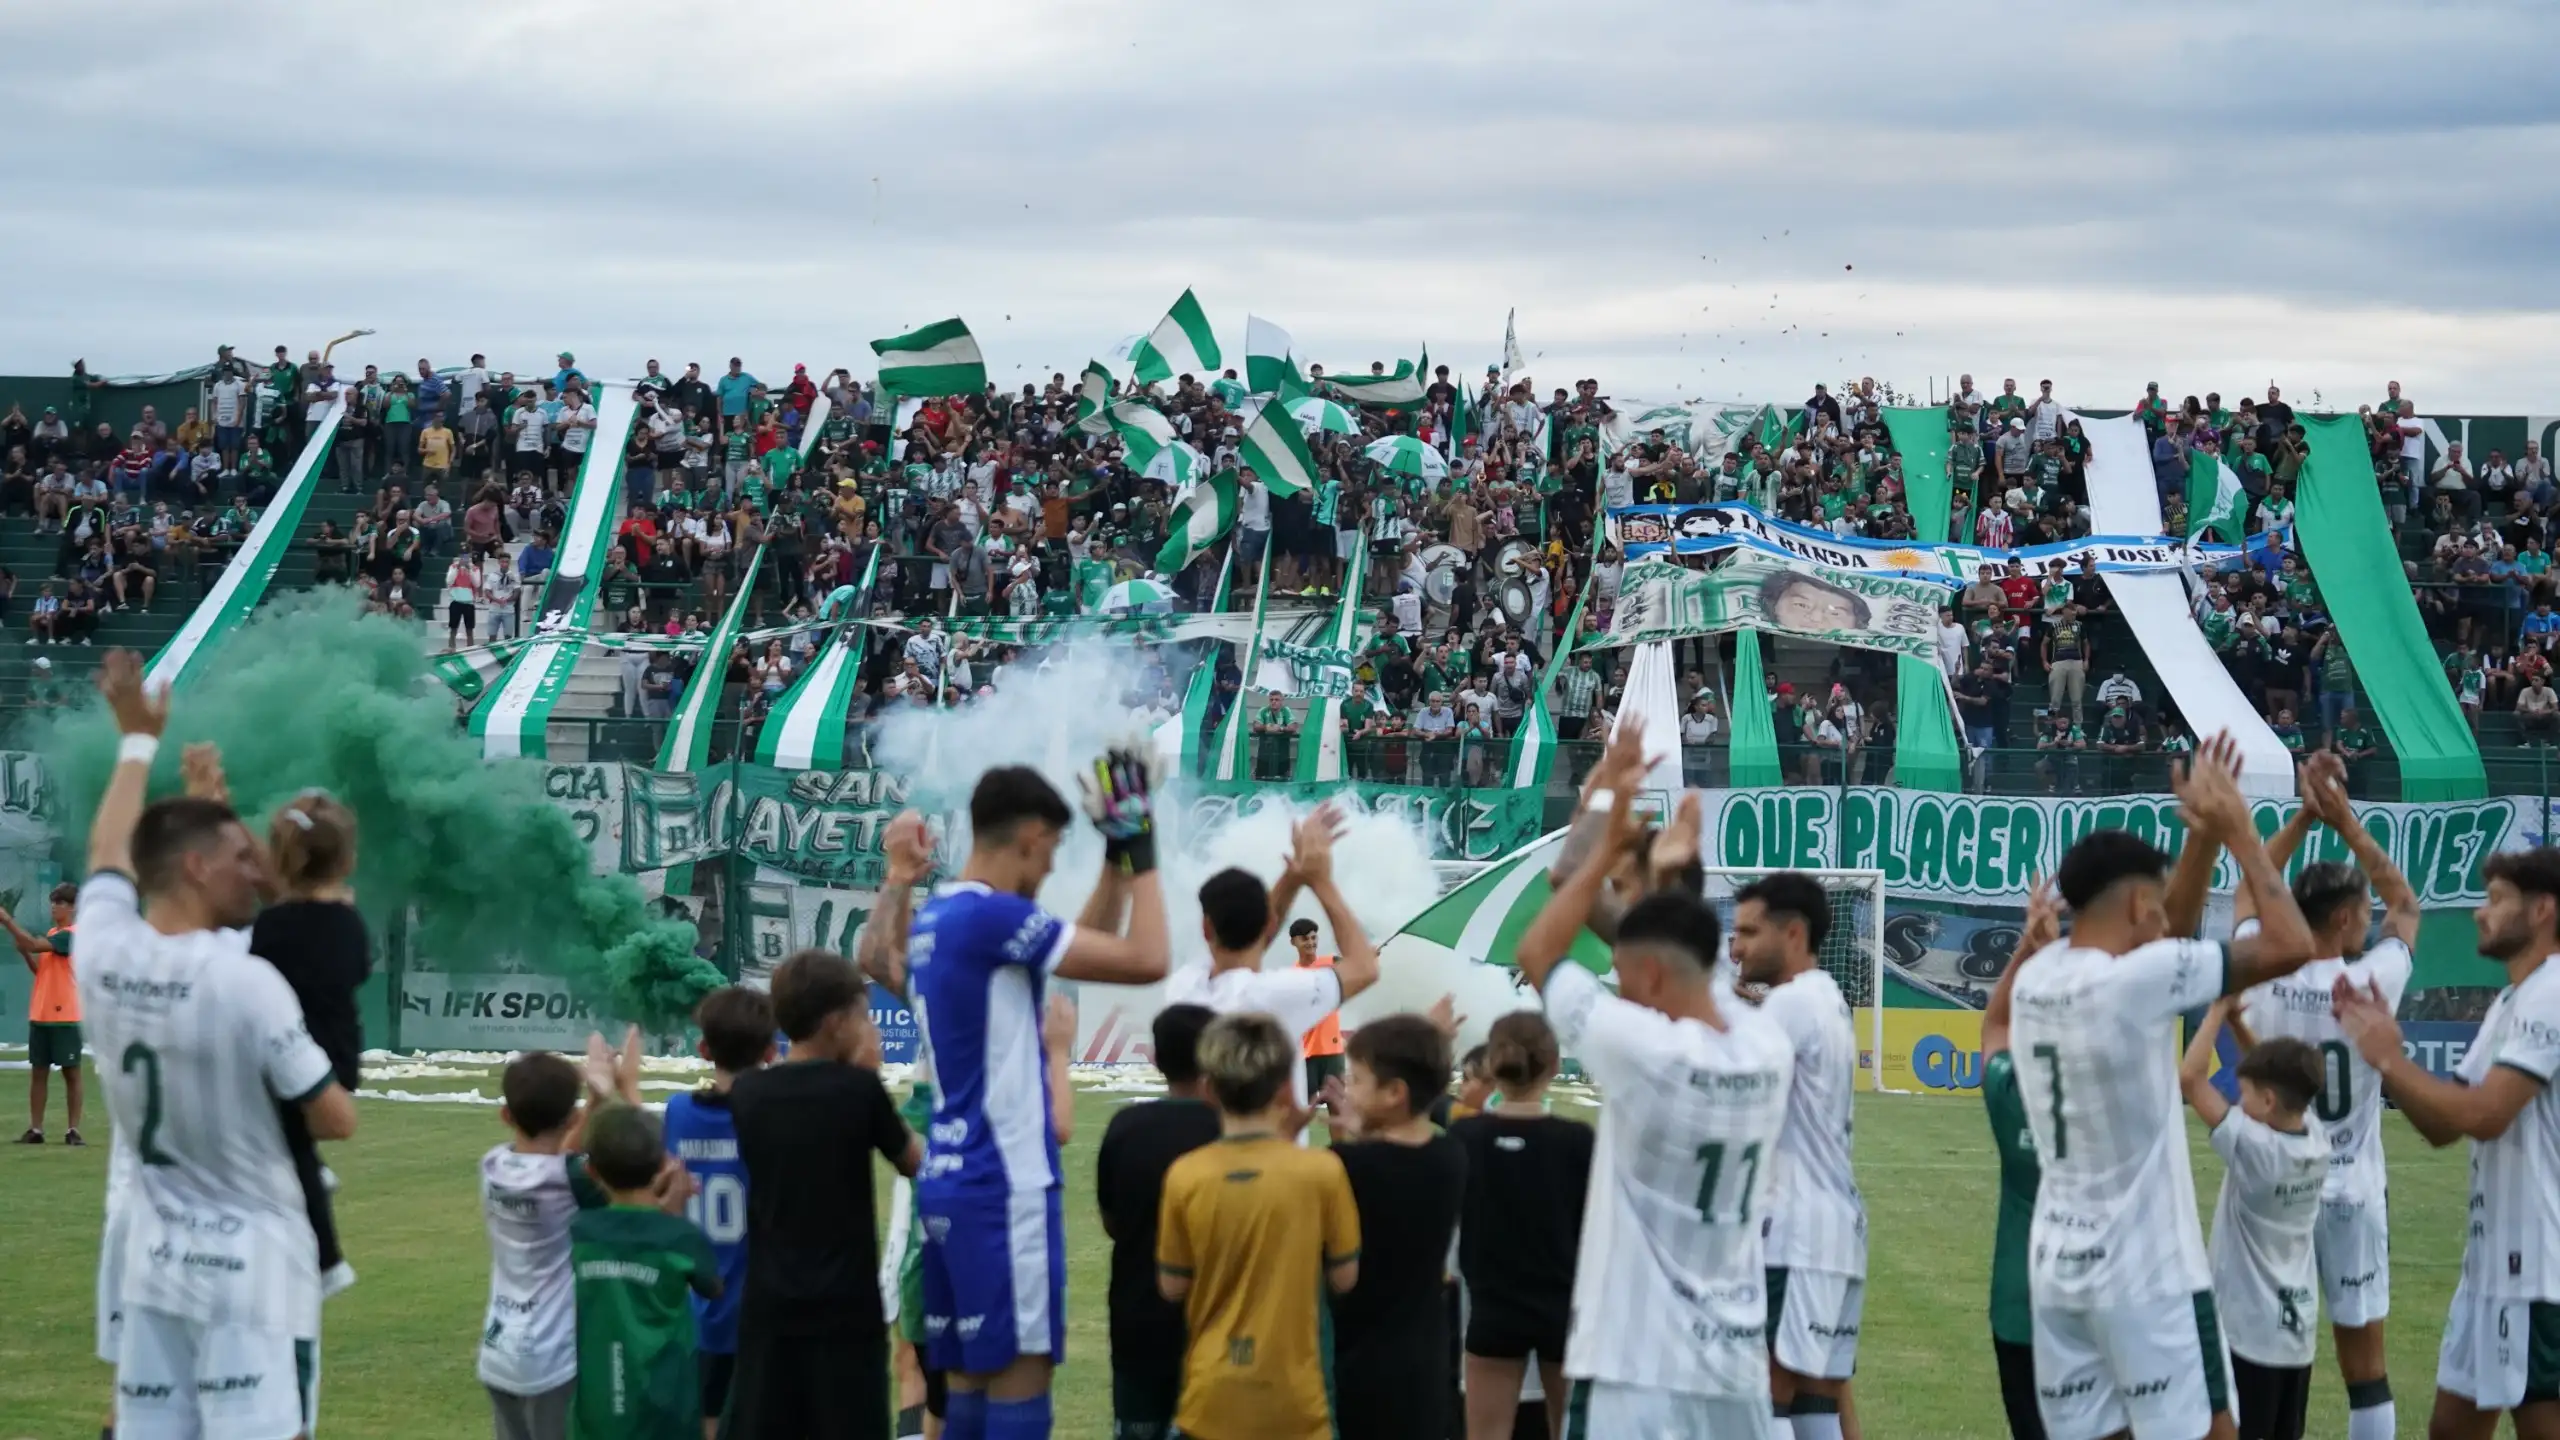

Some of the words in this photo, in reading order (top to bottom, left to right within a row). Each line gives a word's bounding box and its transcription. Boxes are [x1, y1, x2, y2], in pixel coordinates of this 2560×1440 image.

[2107, 545, 2169, 563] JOSÉ
[788, 769, 913, 807] SAN
[1719, 790, 1832, 886] QUE
[1836, 788, 2047, 895] PLACER
[2402, 799, 2516, 902] VEZ
[442, 991, 498, 1018] IFK
[501, 991, 590, 1020] SPOR
[2292, 987, 2332, 1003] NOR
[2032, 1041, 2068, 1160] 7
[1695, 1141, 1763, 1224] 11
